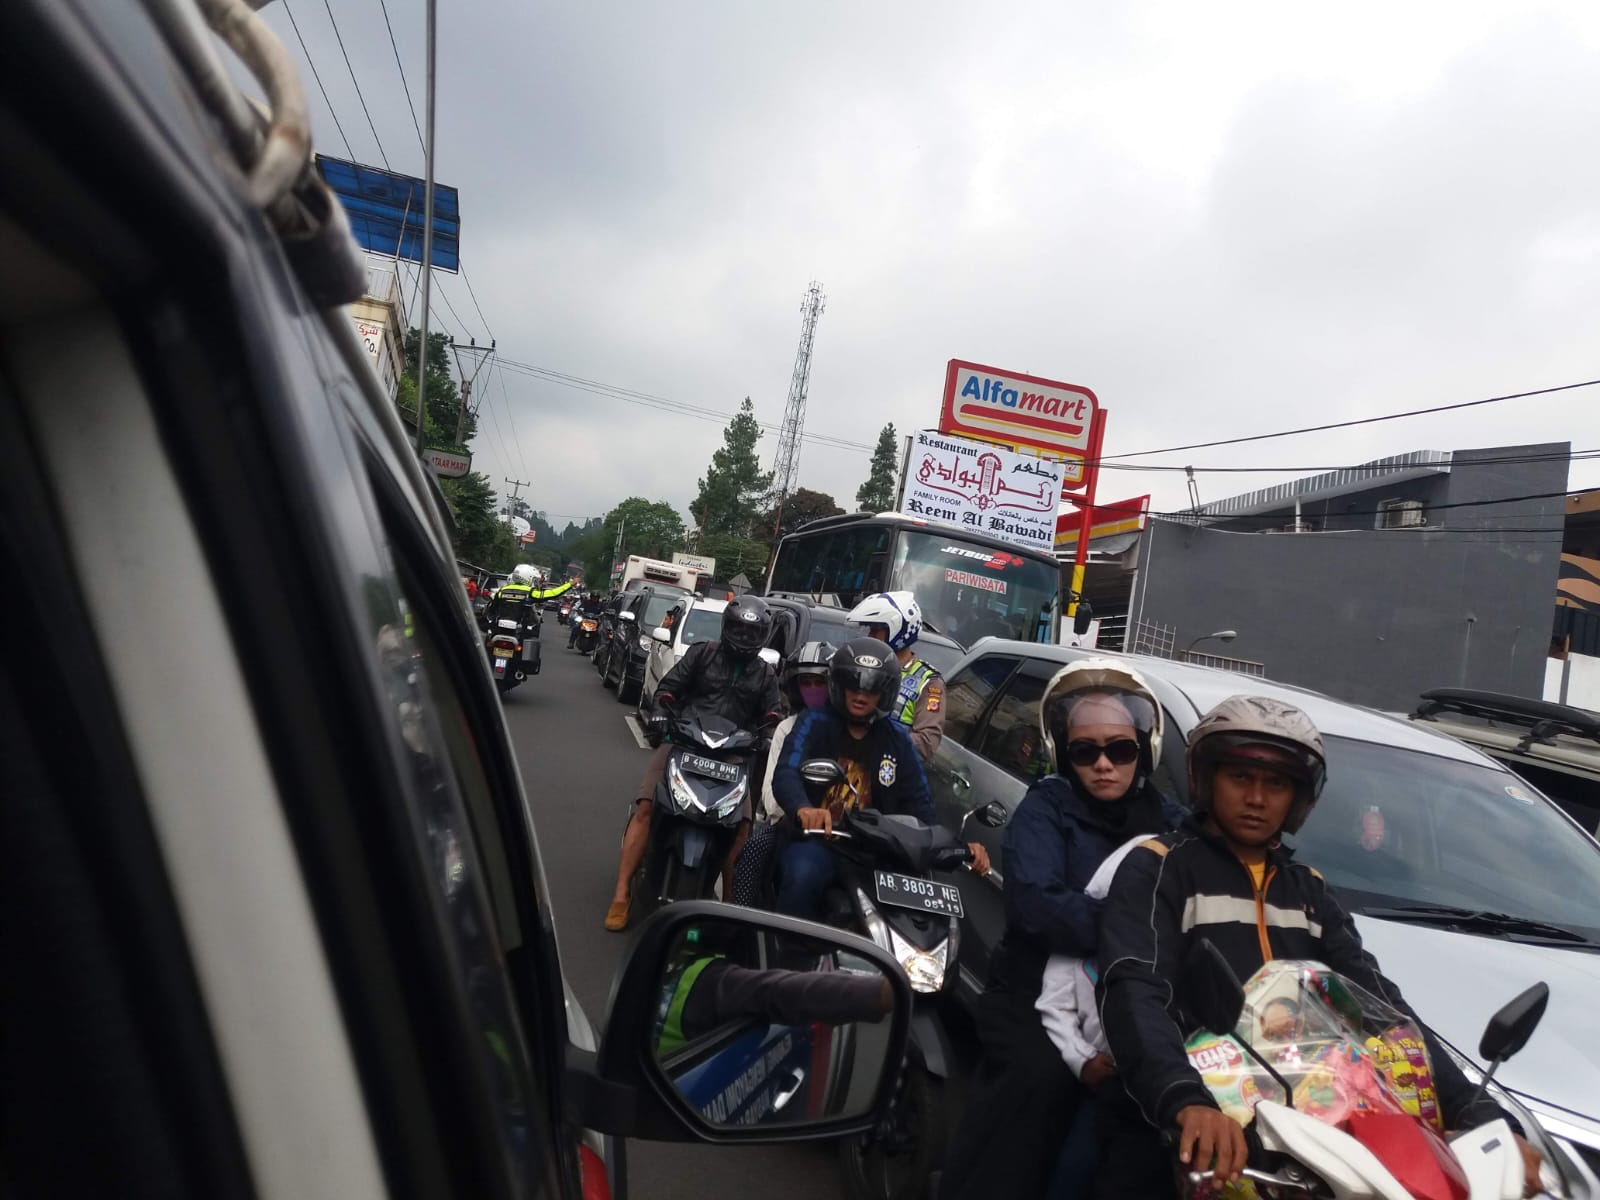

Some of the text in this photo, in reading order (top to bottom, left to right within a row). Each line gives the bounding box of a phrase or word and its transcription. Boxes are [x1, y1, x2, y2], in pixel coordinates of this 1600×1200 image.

[961, 376, 1087, 421] Alfamart
[918, 434, 979, 457] Restaurant
[1011, 461, 1058, 481] مطعم
[913, 490, 961, 507] FAMILY ROOM
[907, 499, 957, 520] Reem
[962, 512, 983, 527] Al
[988, 517, 1053, 541] Bawadi
[945, 570, 1006, 594] PARIWISATA
[880, 873, 894, 888] AB
[902, 878, 934, 897] 3803
